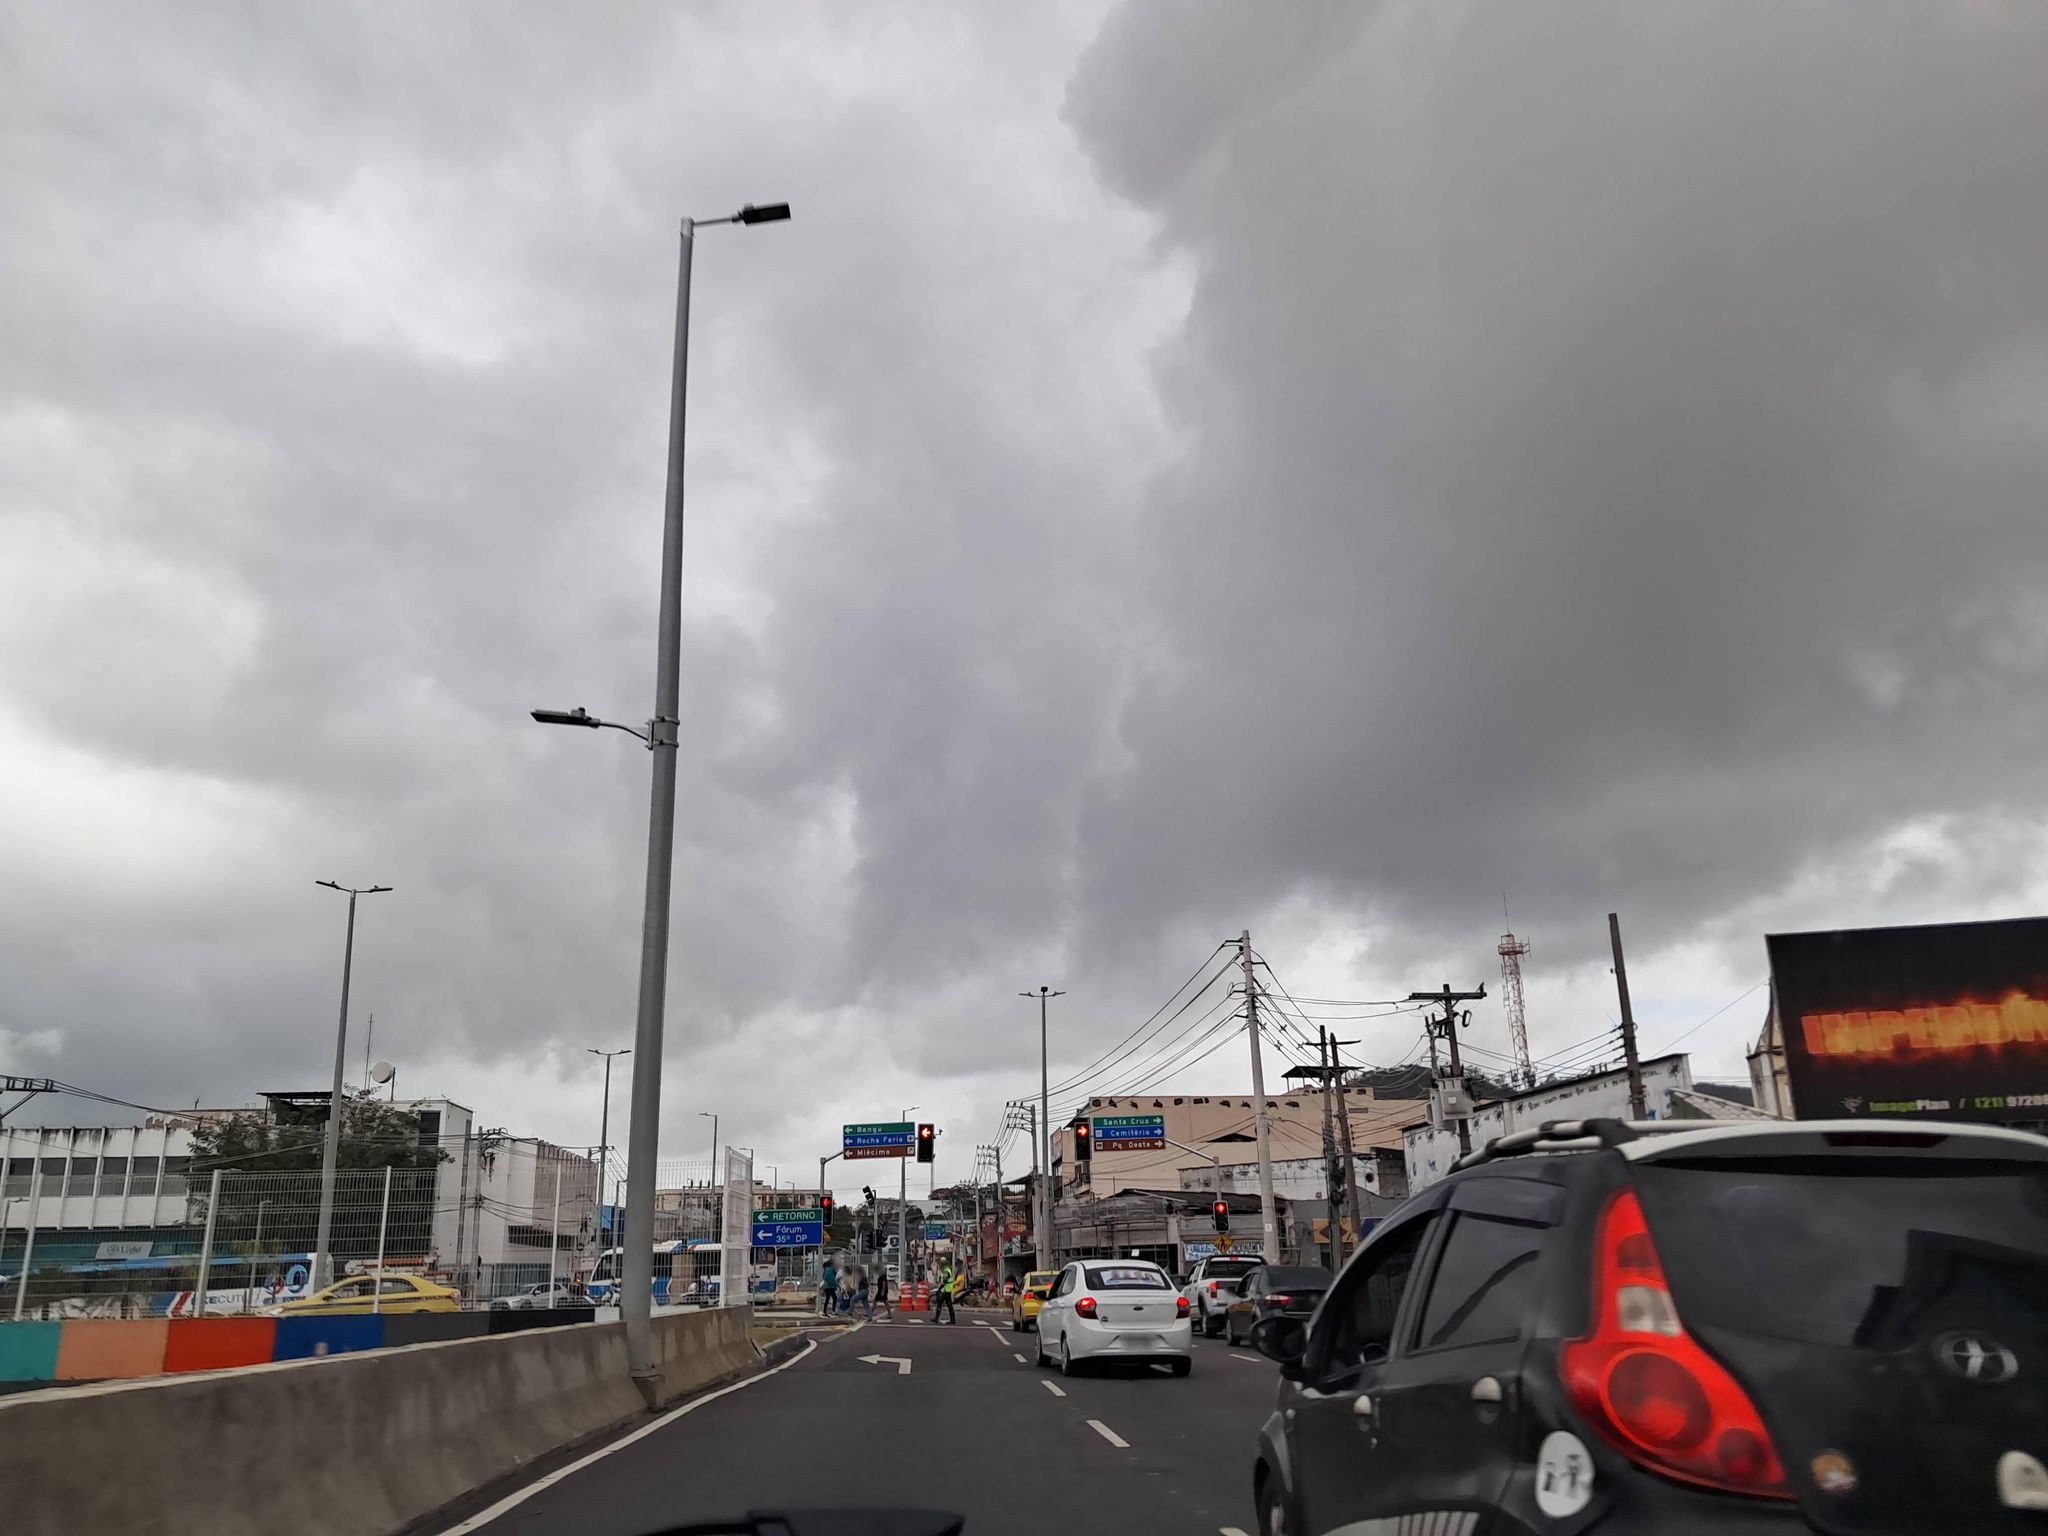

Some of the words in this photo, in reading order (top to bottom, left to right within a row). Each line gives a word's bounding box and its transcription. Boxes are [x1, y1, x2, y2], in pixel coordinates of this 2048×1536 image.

[772, 1211, 816, 1221] RETORNO
[775, 1225, 803, 1234] Fórum
[795, 1234, 808, 1243] DP
